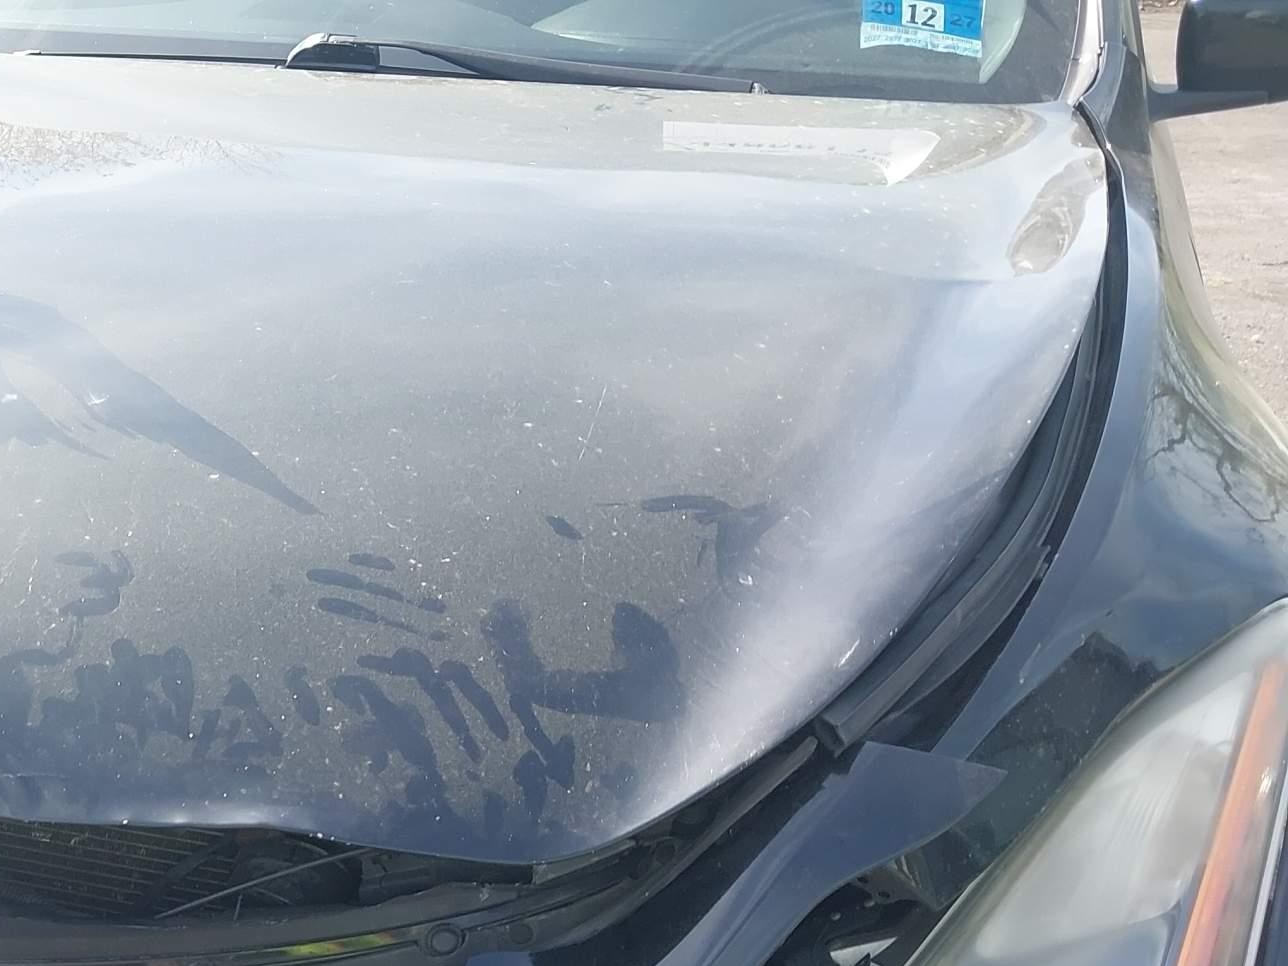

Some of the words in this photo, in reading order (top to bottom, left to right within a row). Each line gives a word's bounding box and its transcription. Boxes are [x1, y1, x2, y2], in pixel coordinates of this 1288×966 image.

[871, 0, 896, 16] 20
[905, 3, 938, 28] 12
[950, 13, 977, 29] 27
